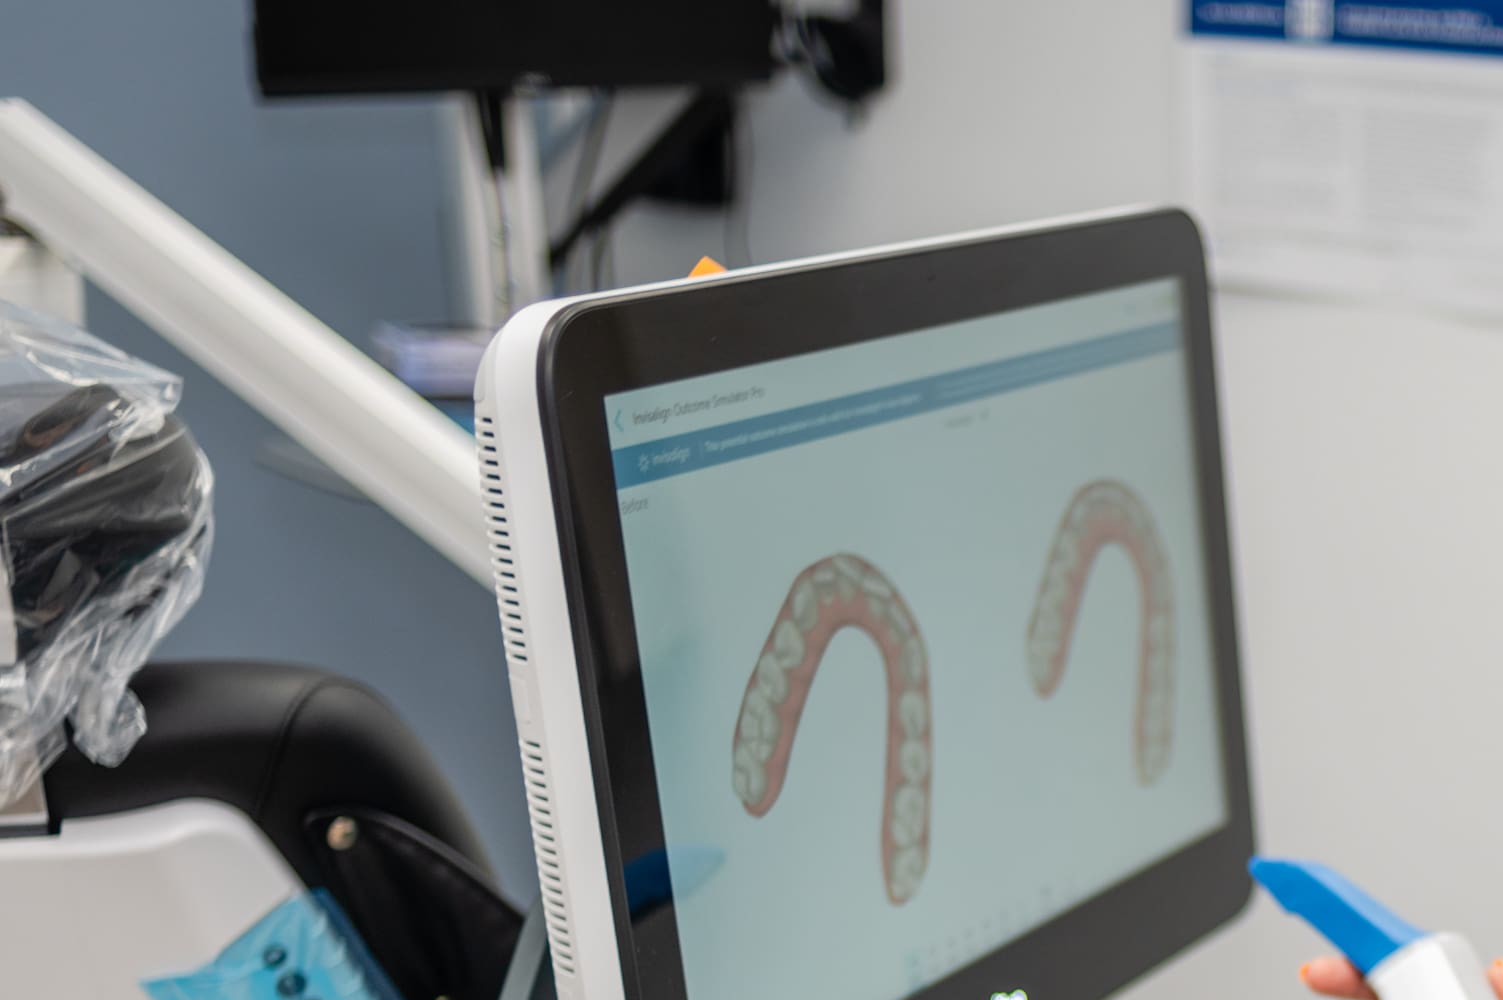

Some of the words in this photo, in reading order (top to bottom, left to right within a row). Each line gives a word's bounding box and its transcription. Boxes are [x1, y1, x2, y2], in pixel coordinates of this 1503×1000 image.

[632, 406, 671, 425] Invisalign
[673, 398, 711, 417] Outcome
[712, 390, 748, 410] Simulator
